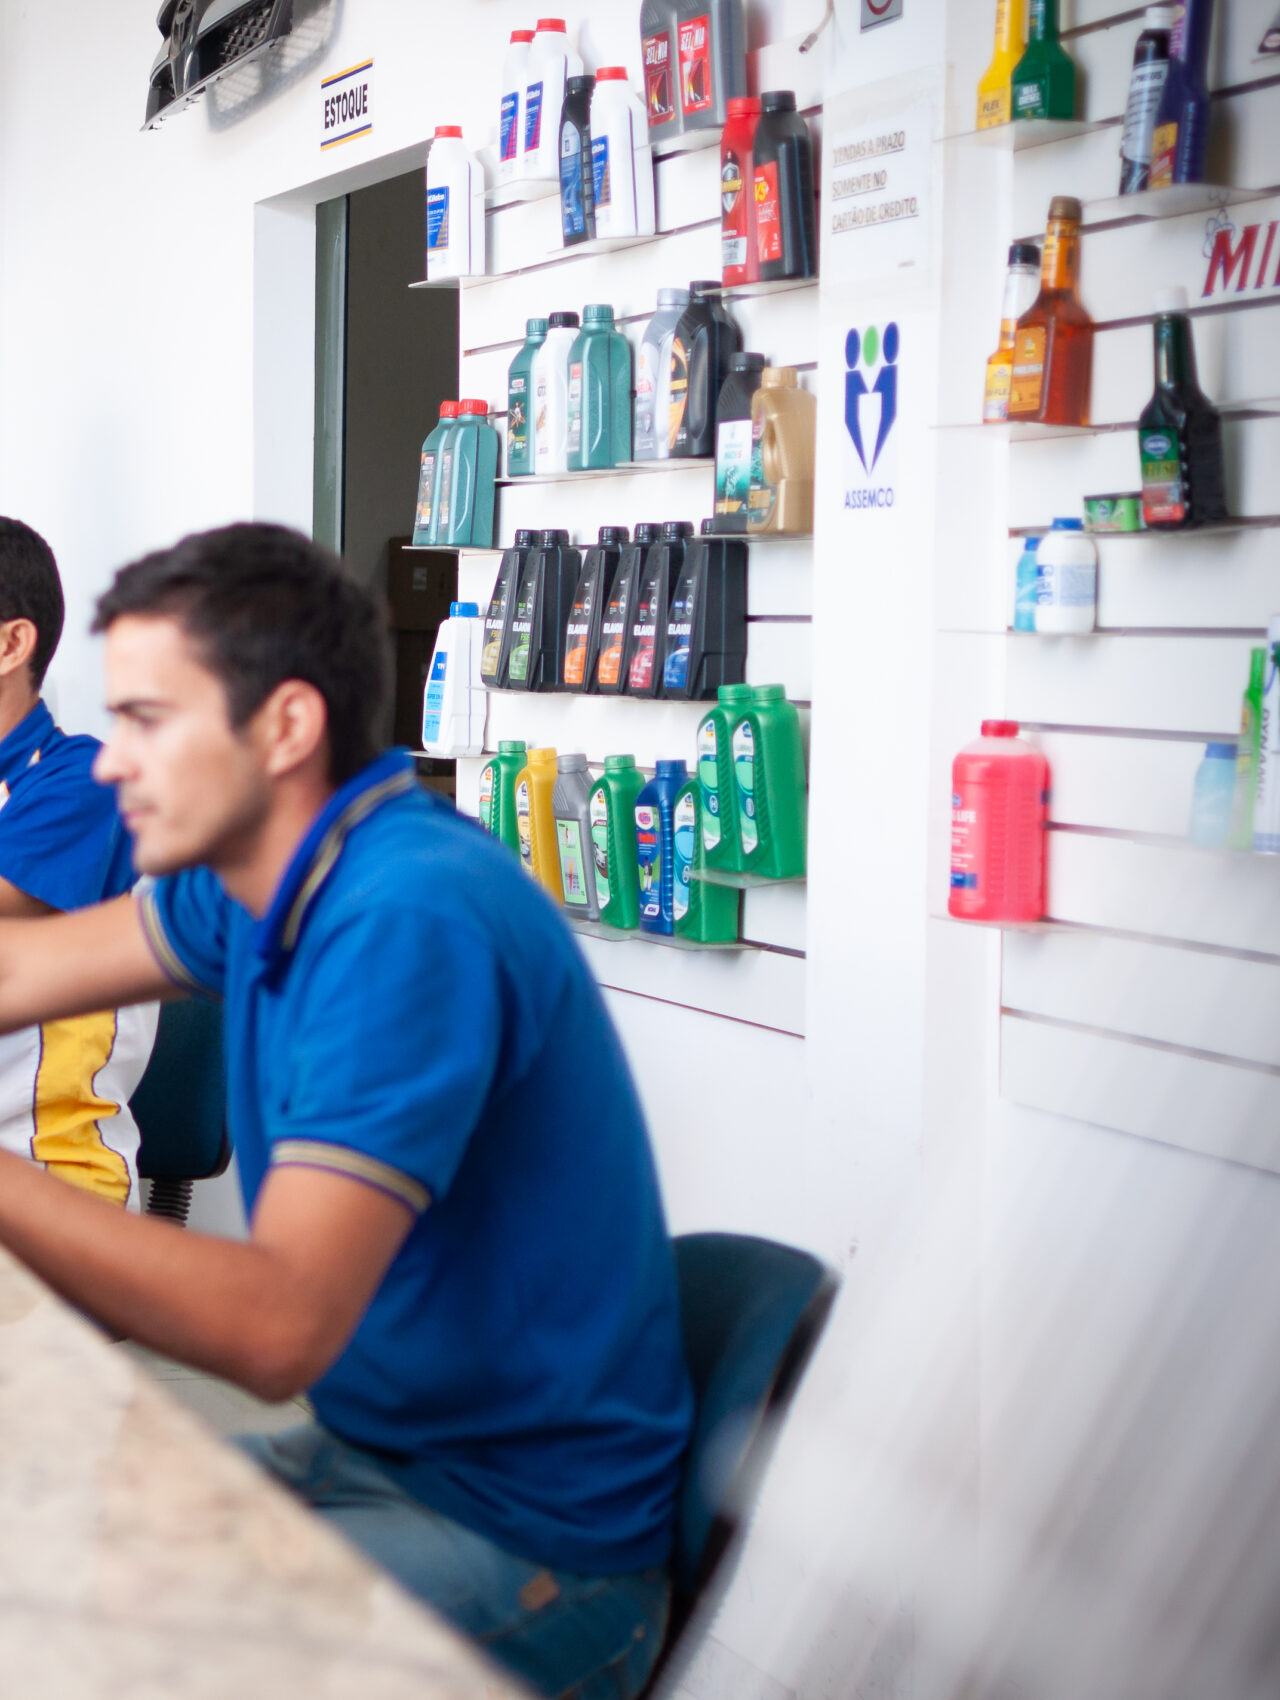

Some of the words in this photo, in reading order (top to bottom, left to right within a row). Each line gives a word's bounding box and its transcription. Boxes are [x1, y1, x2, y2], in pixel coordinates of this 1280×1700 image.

[324, 83, 368, 129] ESTOQUE
[832, 141, 866, 164] VENDAS
[868, 141, 875, 156] A
[875, 130, 905, 153] PRAZO
[832, 173, 871, 198] SOMENTE
[873, 169, 888, 188] NO
[832, 206, 863, 231] CARTÃO
[865, 205, 877, 223] DE
[1201, 220, 1280, 298] MI
[844, 487, 895, 510] ASSEMCO
[957, 810, 976, 823] LIFE
